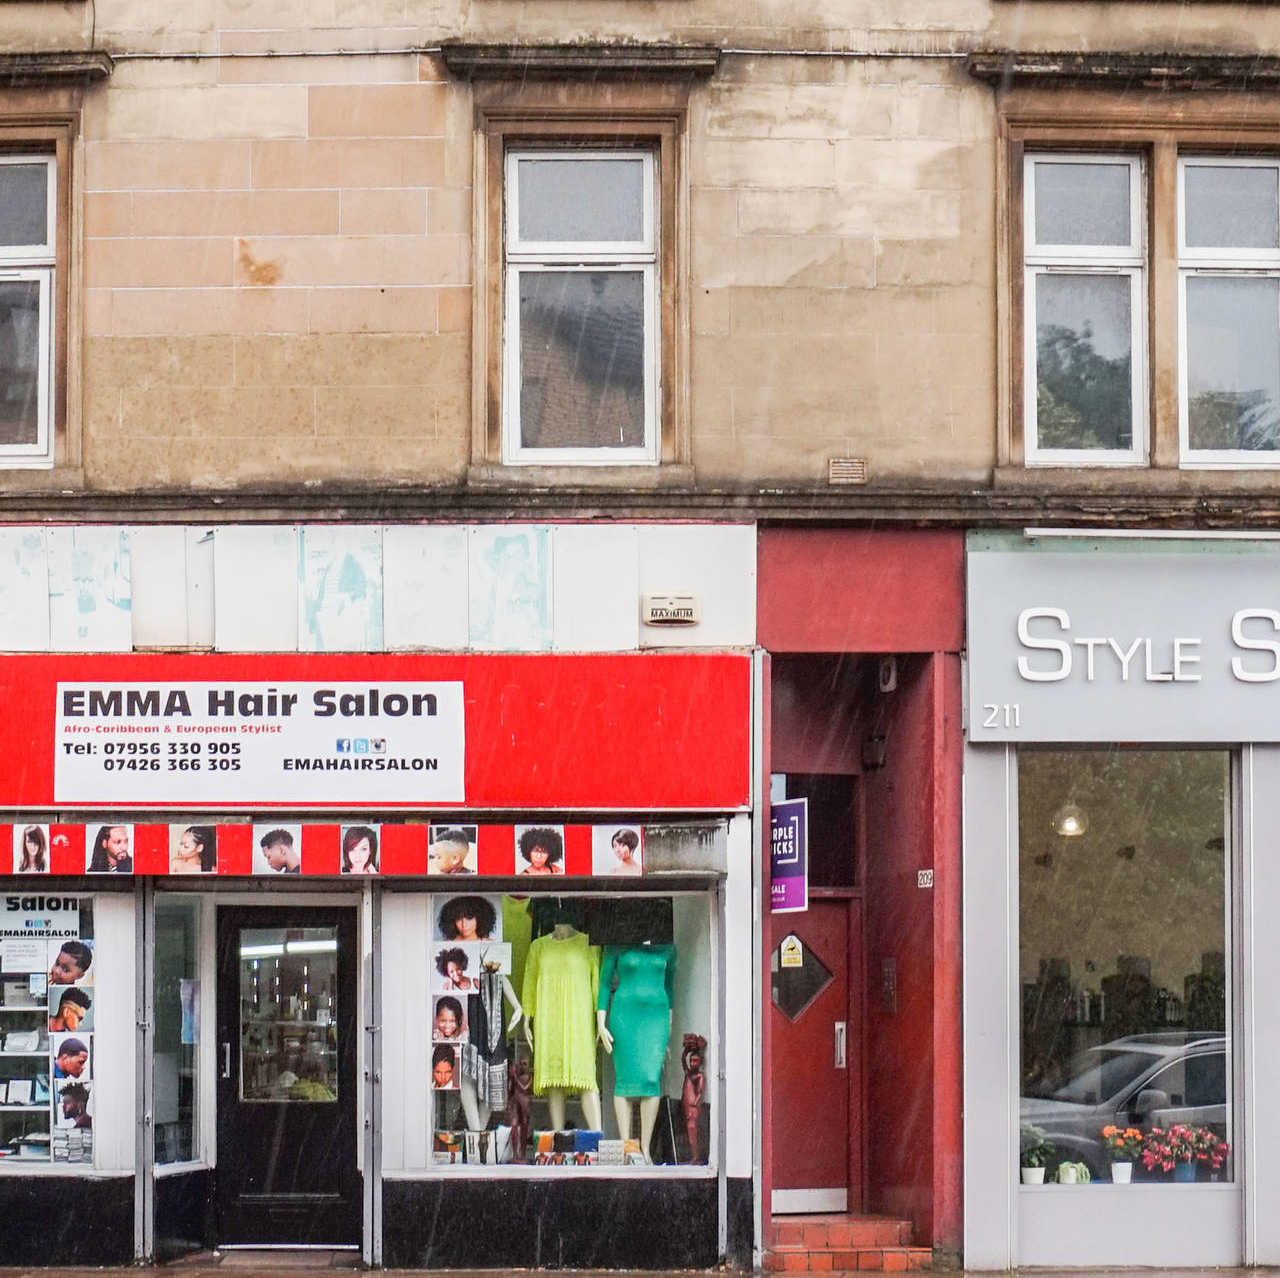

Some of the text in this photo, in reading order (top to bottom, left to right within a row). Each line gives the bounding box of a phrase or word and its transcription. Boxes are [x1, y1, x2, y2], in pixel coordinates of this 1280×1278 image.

[651, 609, 693, 619] MAXIMUM
[63, 688, 439, 718] EMMA Hair Salon
[982, 704, 1021, 729] 211
[63, 723, 282, 736] Afro-Caribbean & European Stylist
[63, 741, 242, 756] Tel: 07956 330 905
[103, 758, 242, 772] 07426 366 305
[283, 757, 439, 772] EMAHAIRSALON
[772, 825, 794, 841] RPLE
[771, 841, 794, 855] ICKS
[6, 895, 78, 912] Salon
